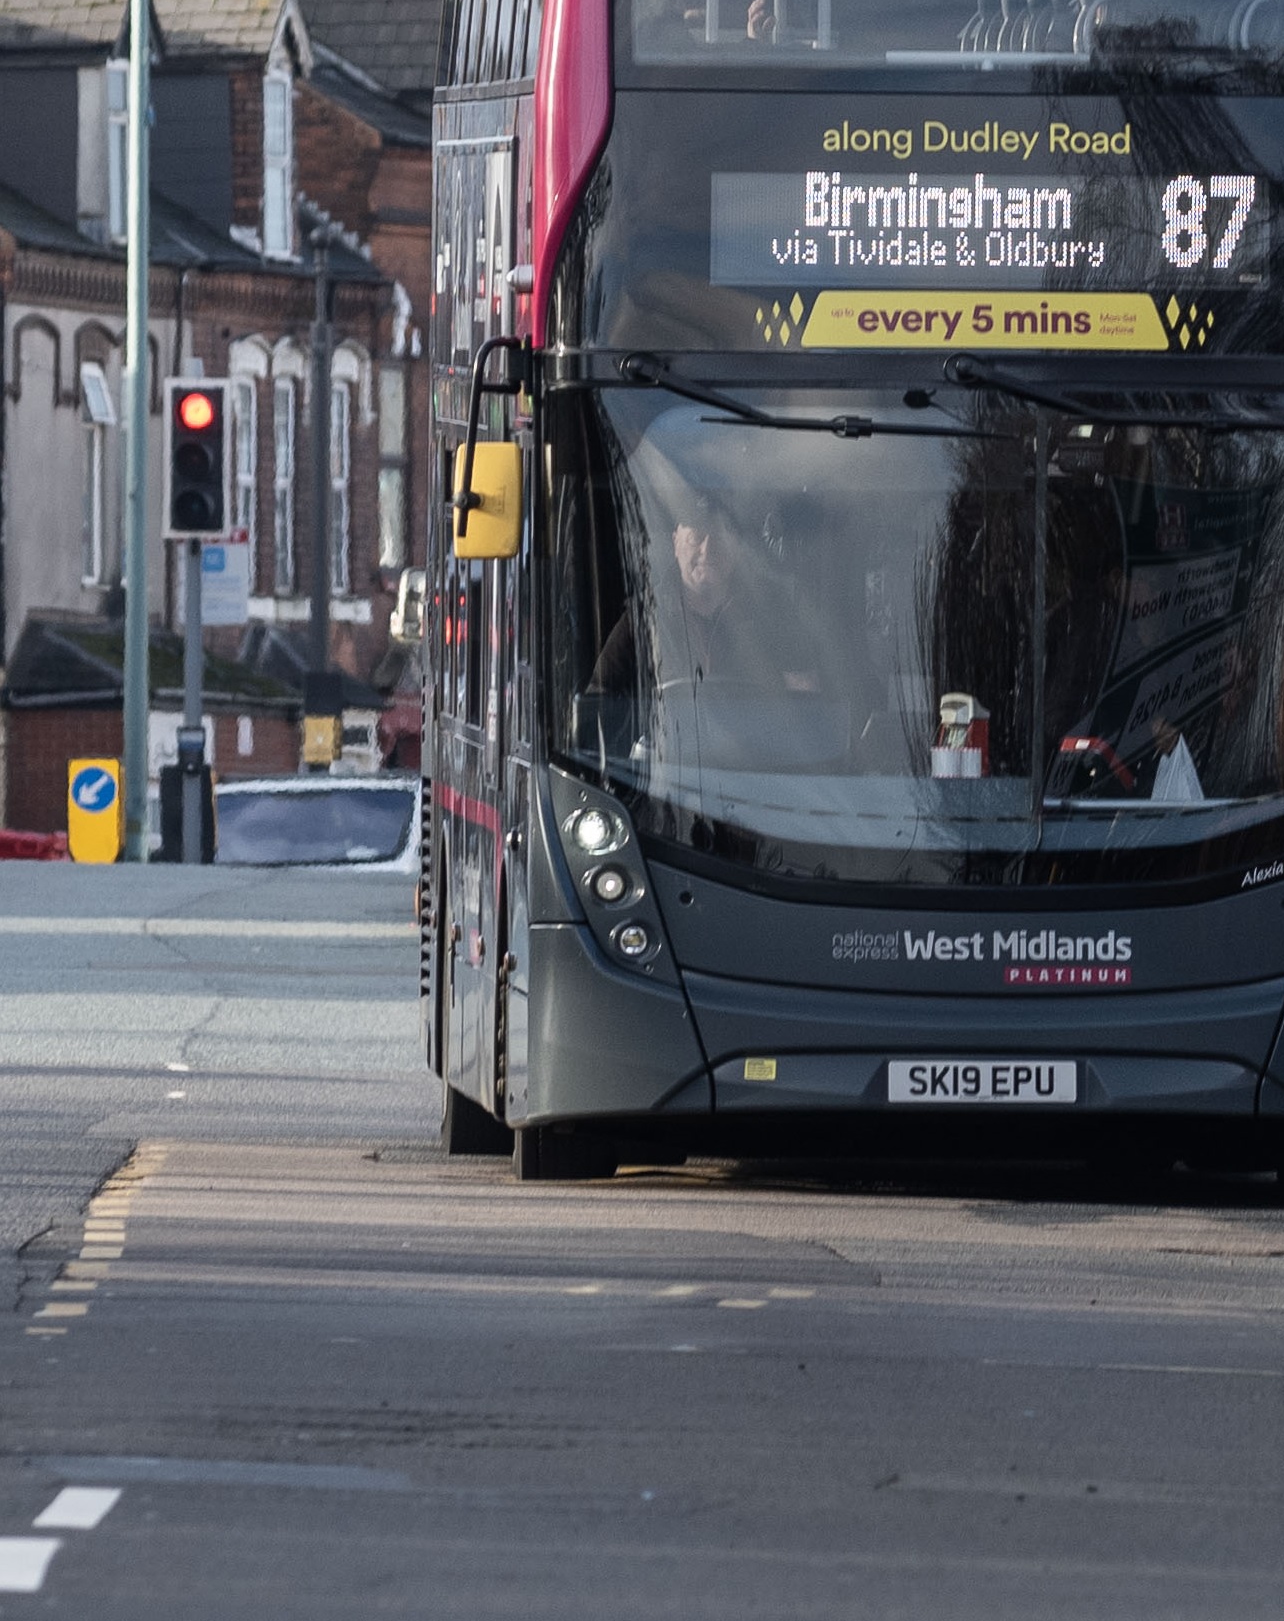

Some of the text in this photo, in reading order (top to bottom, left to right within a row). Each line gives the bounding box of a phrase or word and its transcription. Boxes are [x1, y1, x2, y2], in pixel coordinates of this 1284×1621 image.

[823, 120, 1132, 160] along Dudley Road
[805, 171, 1072, 229] Birmingham
[1161, 175, 1256, 268] 87
[772, 230, 1105, 268] via Tividale & Oldbury
[857, 301, 1092, 341] every 5 mins
[1240, 860, 1284, 888] Alexia
[831, 930, 1133, 961] national West Midlands
[831, 947, 899, 964] express
[1009, 968, 1128, 982] PLATINUM
[908, 1065, 1056, 1096] SK19 EPU
